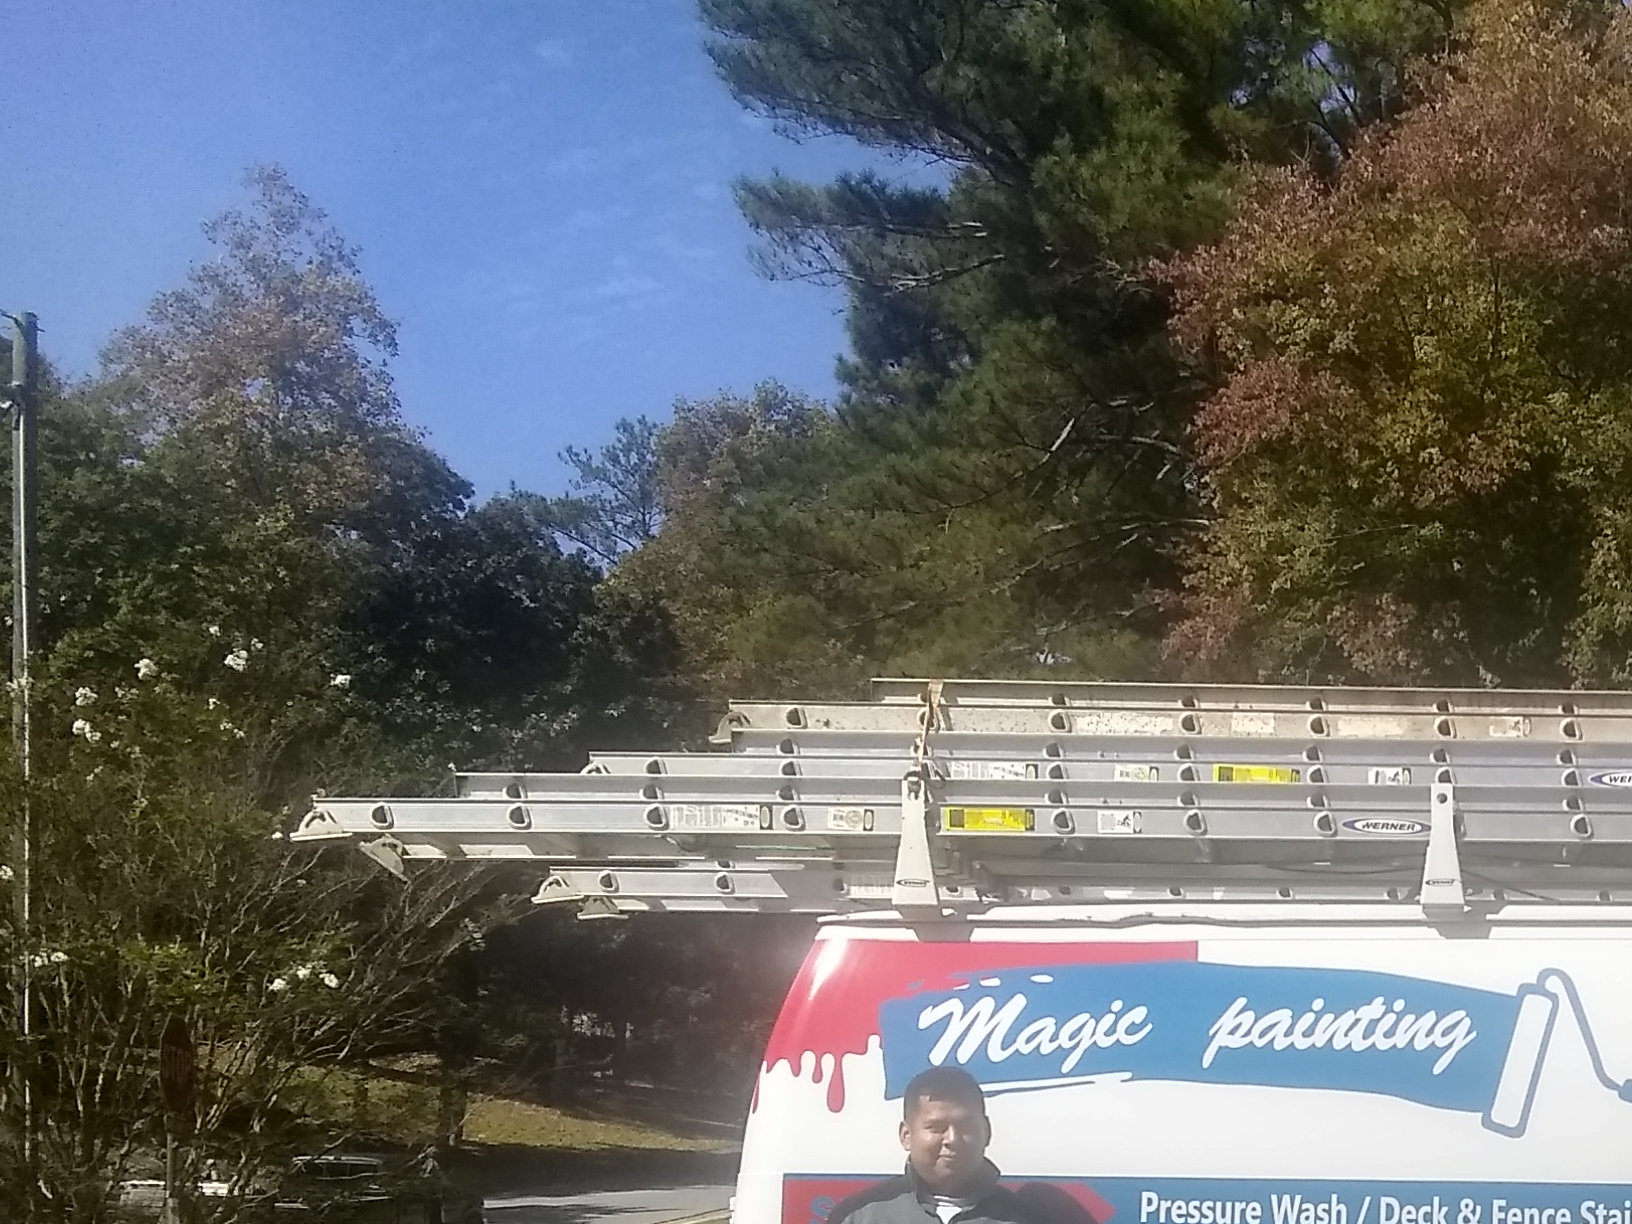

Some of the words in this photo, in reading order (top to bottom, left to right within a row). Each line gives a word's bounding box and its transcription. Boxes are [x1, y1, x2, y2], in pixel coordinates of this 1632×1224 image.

[1361, 820, 1416, 832] WERNER
[917, 992, 1153, 1074] Magic
[1202, 996, 1478, 1076] painting
[1140, 1190, 1262, 1224] Pressure
